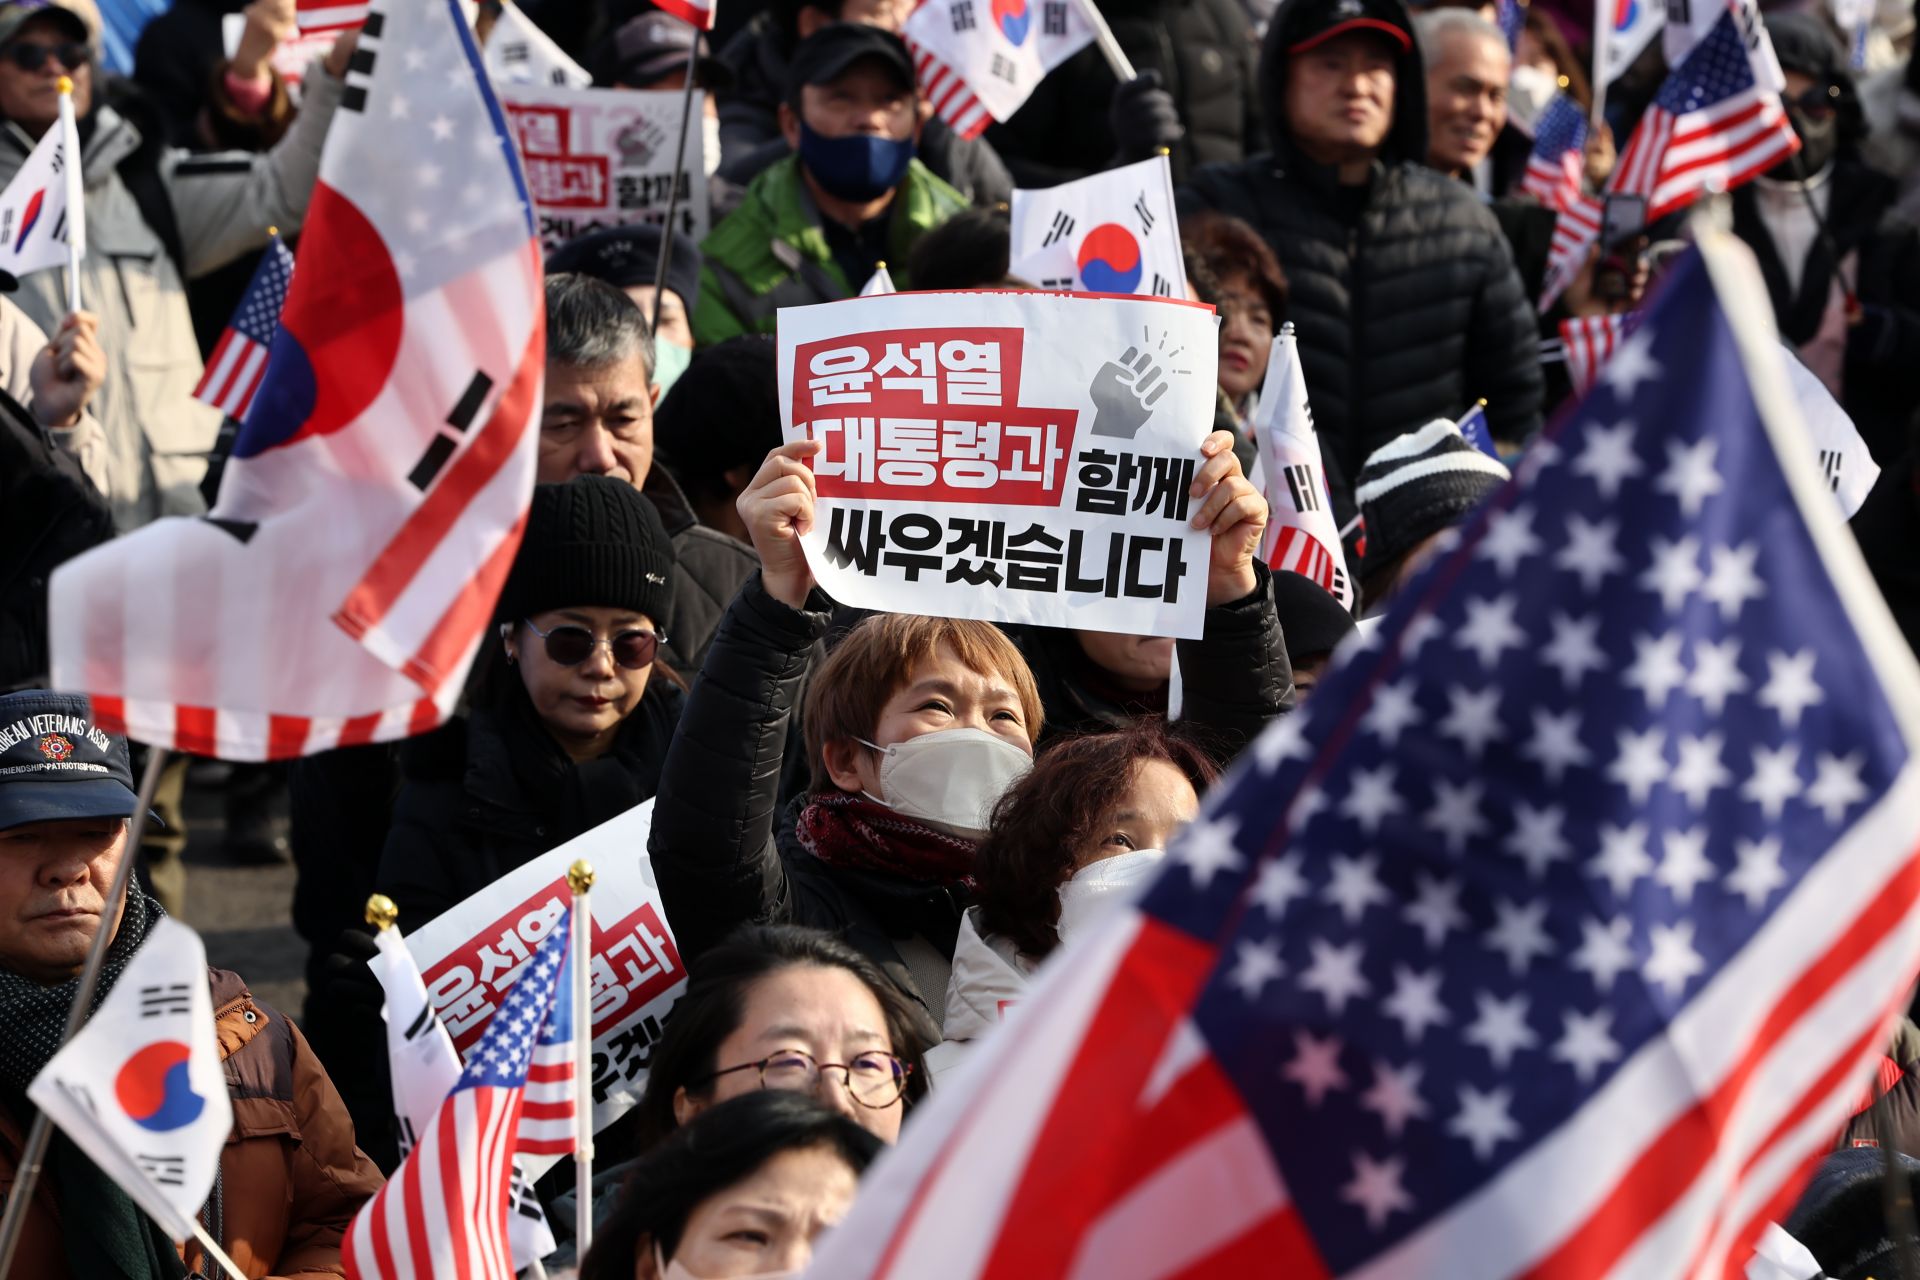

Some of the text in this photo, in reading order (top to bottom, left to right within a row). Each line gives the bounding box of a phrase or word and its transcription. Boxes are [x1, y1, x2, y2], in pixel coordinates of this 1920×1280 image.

[808, 339, 1003, 407] 윤석열
[811, 416, 1196, 521] 대통령과 함께
[823, 507, 1188, 604] 싸우겠습니다
[28, 713, 87, 736] VETERANS
[86, 725, 111, 753] ASSN
